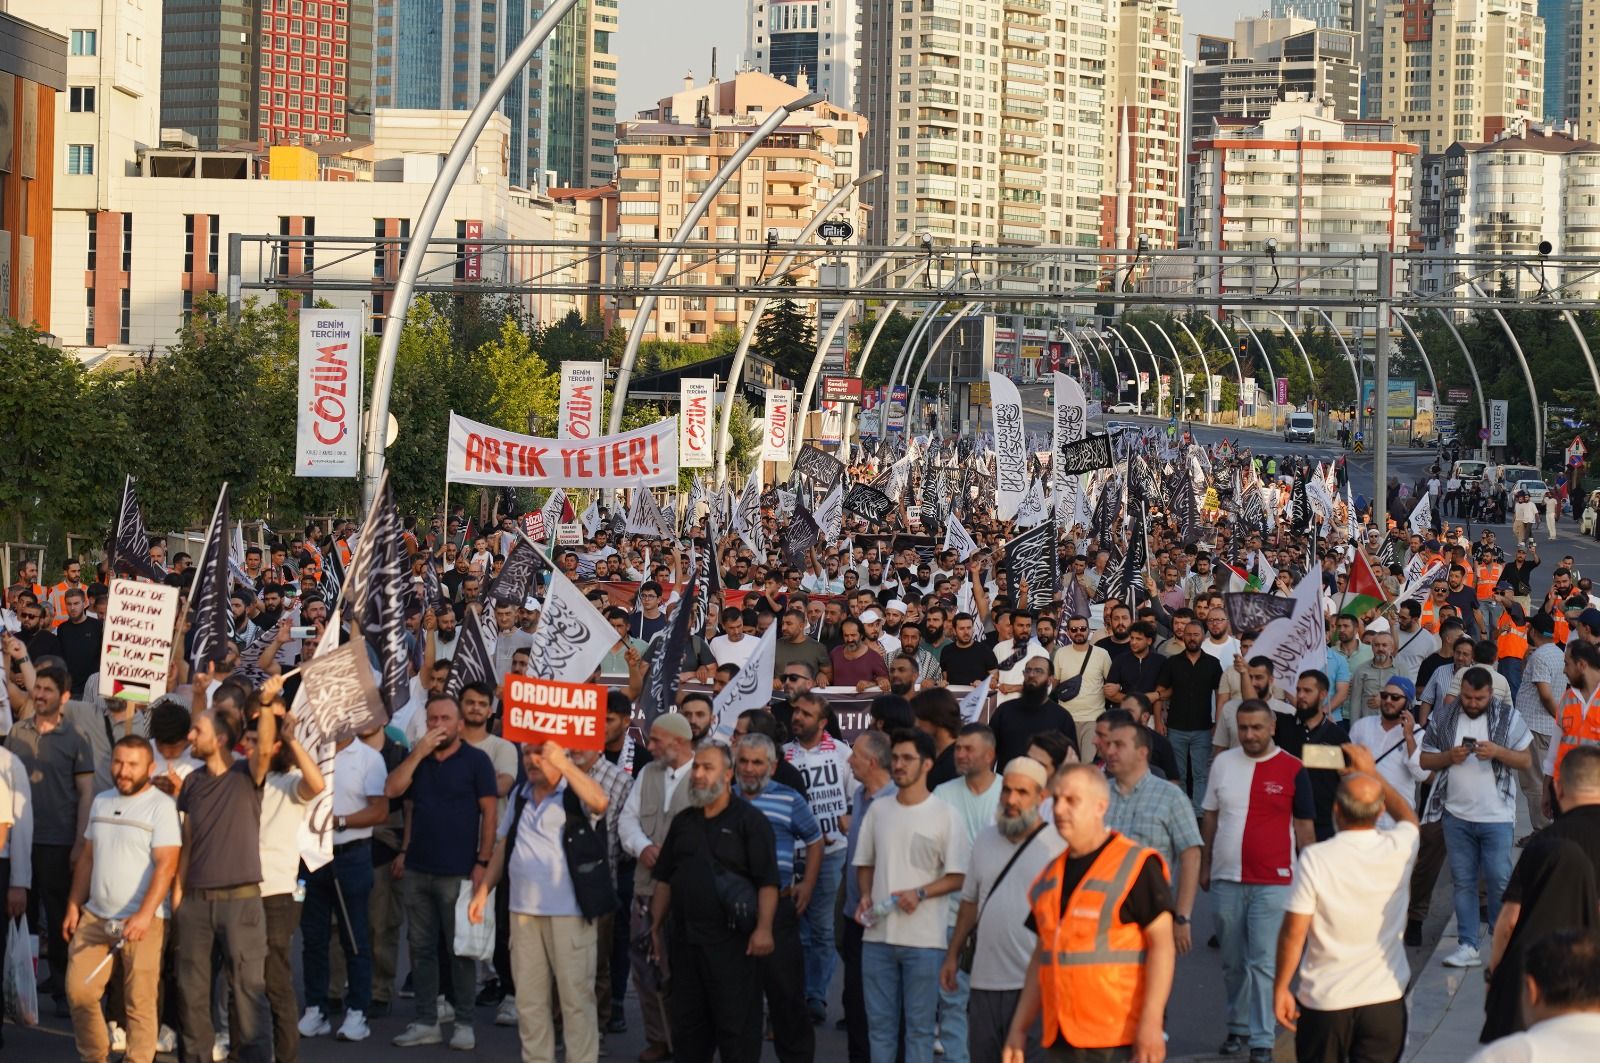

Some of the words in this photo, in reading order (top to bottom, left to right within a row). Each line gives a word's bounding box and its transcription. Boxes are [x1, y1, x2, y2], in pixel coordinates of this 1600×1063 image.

[310, 330, 350, 339] TERCİHİM
[317, 320, 344, 329] BENİM
[309, 343, 348, 445] ÇÖZÜM
[565, 385, 593, 440] ÖZÜM
[686, 396, 707, 451] ÇÖZÜM
[769, 404, 787, 448] ÇÖZÜM
[1492, 405, 1501, 437] CRITER
[465, 432, 549, 477] ARTIK
[560, 434, 660, 478] YETER!
[510, 680, 598, 711] ORDULAR
[509, 706, 597, 737] GAZZE'YE
[799, 759, 839, 789] ÖZÜ
[812, 800, 845, 815] EMEYE
